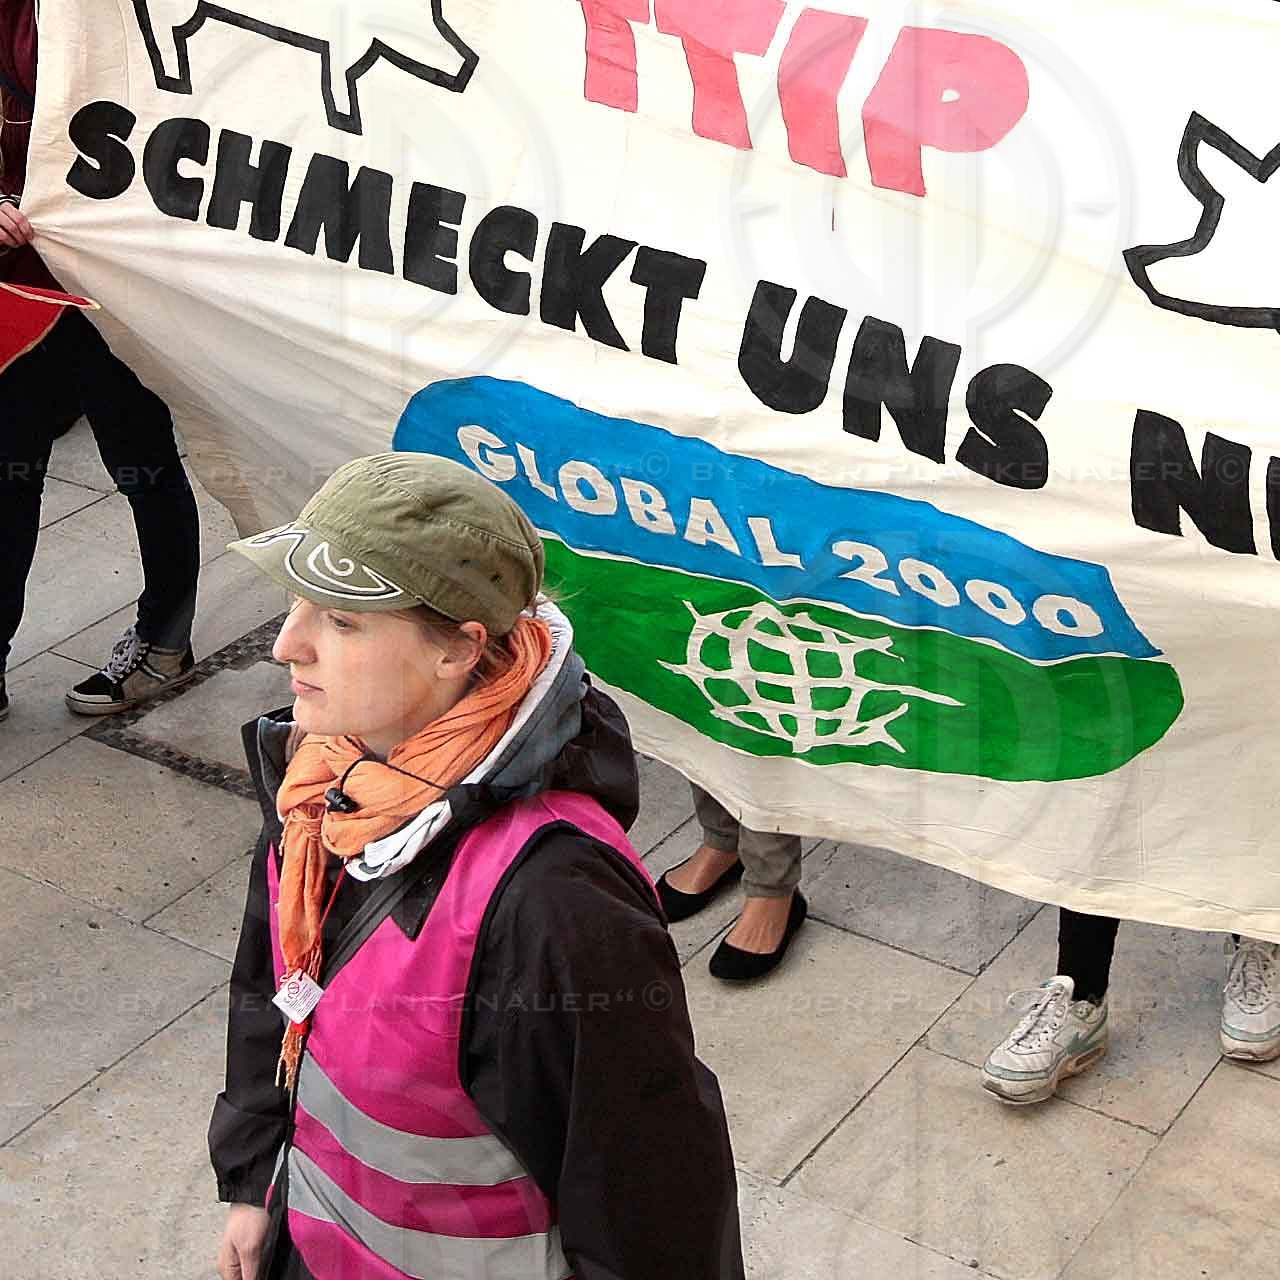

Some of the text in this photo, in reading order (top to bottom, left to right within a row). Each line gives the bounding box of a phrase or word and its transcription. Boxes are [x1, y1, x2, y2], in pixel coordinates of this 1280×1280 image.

[64, 99, 708, 366] SCHMECKT
[737, 279, 1054, 490] UNS
[456, 422, 1105, 640] GLOBAL 2000
